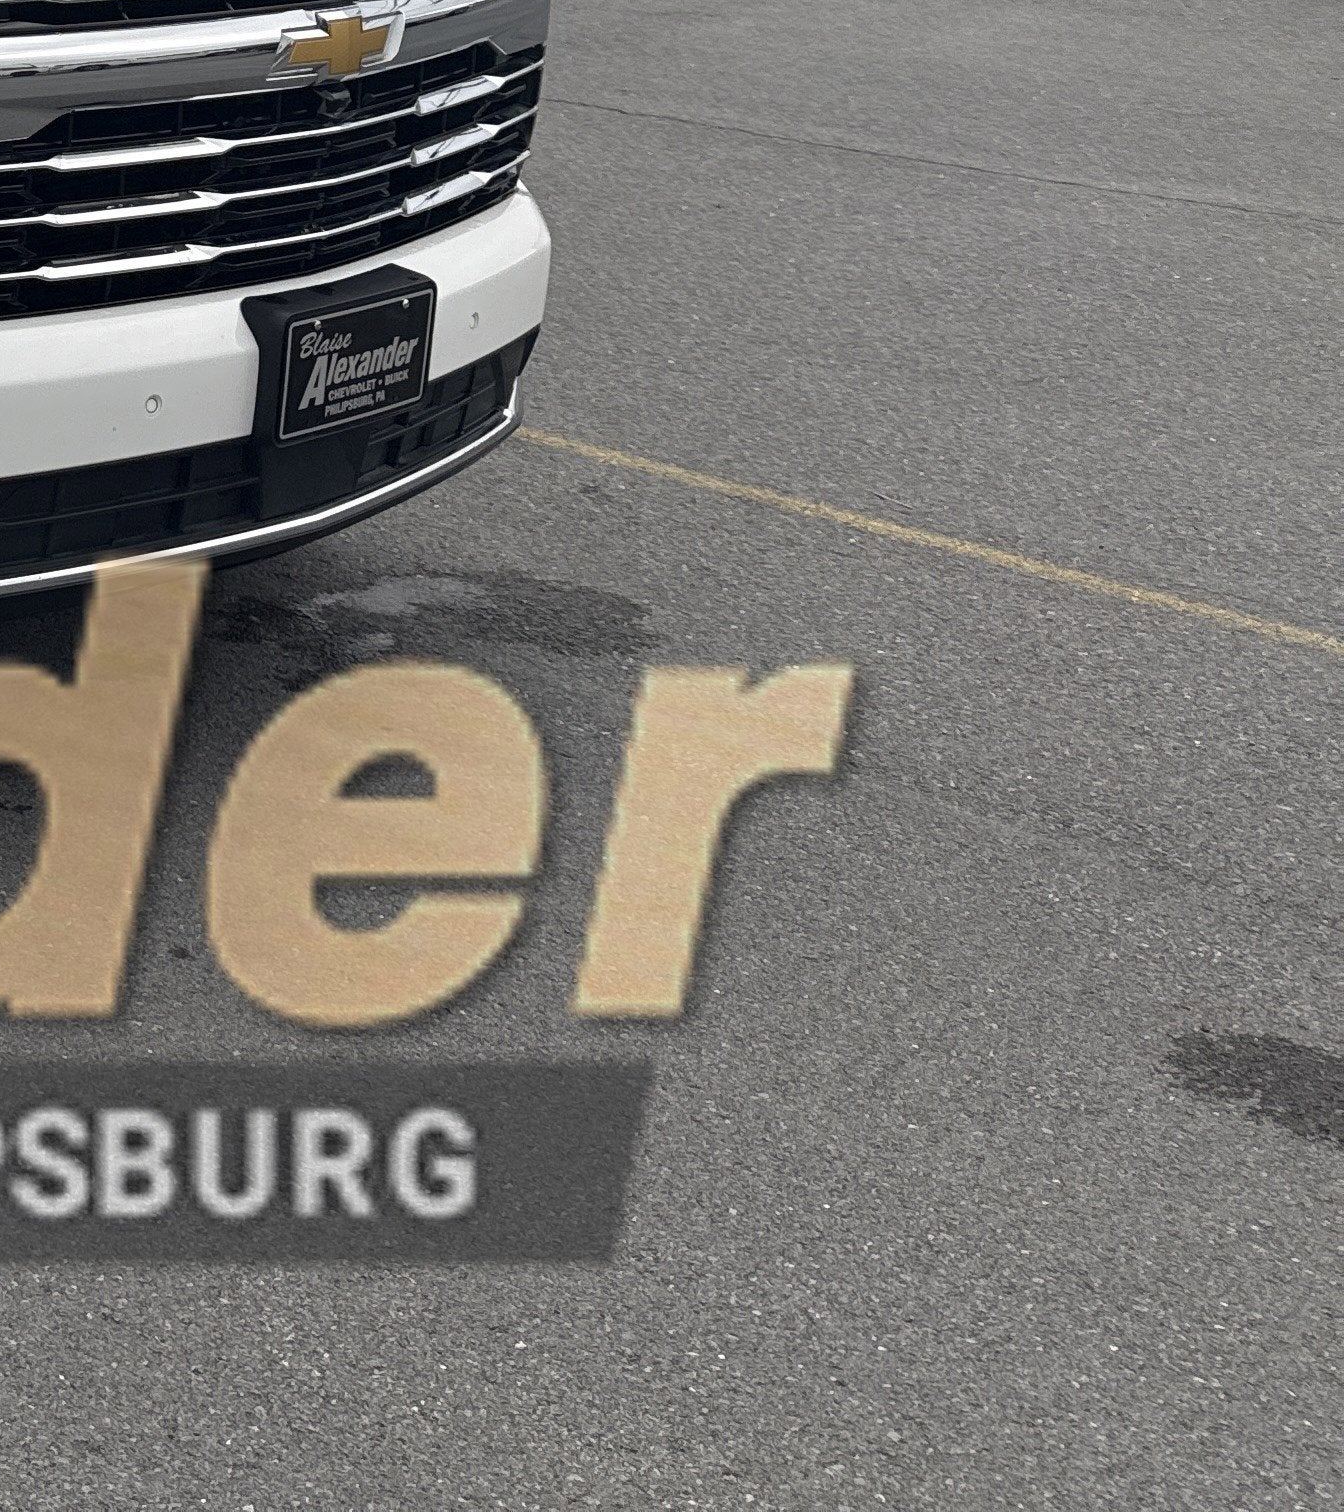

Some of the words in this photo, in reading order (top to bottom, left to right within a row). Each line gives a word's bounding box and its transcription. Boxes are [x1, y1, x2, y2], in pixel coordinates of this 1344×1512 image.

[299, 330, 353, 359] Blaise
[298, 336, 419, 410] Alexander
[328, 378, 377, 402] CHEVROLET
[384, 369, 410, 386] BUICK
[375, 390, 386, 402] PA
